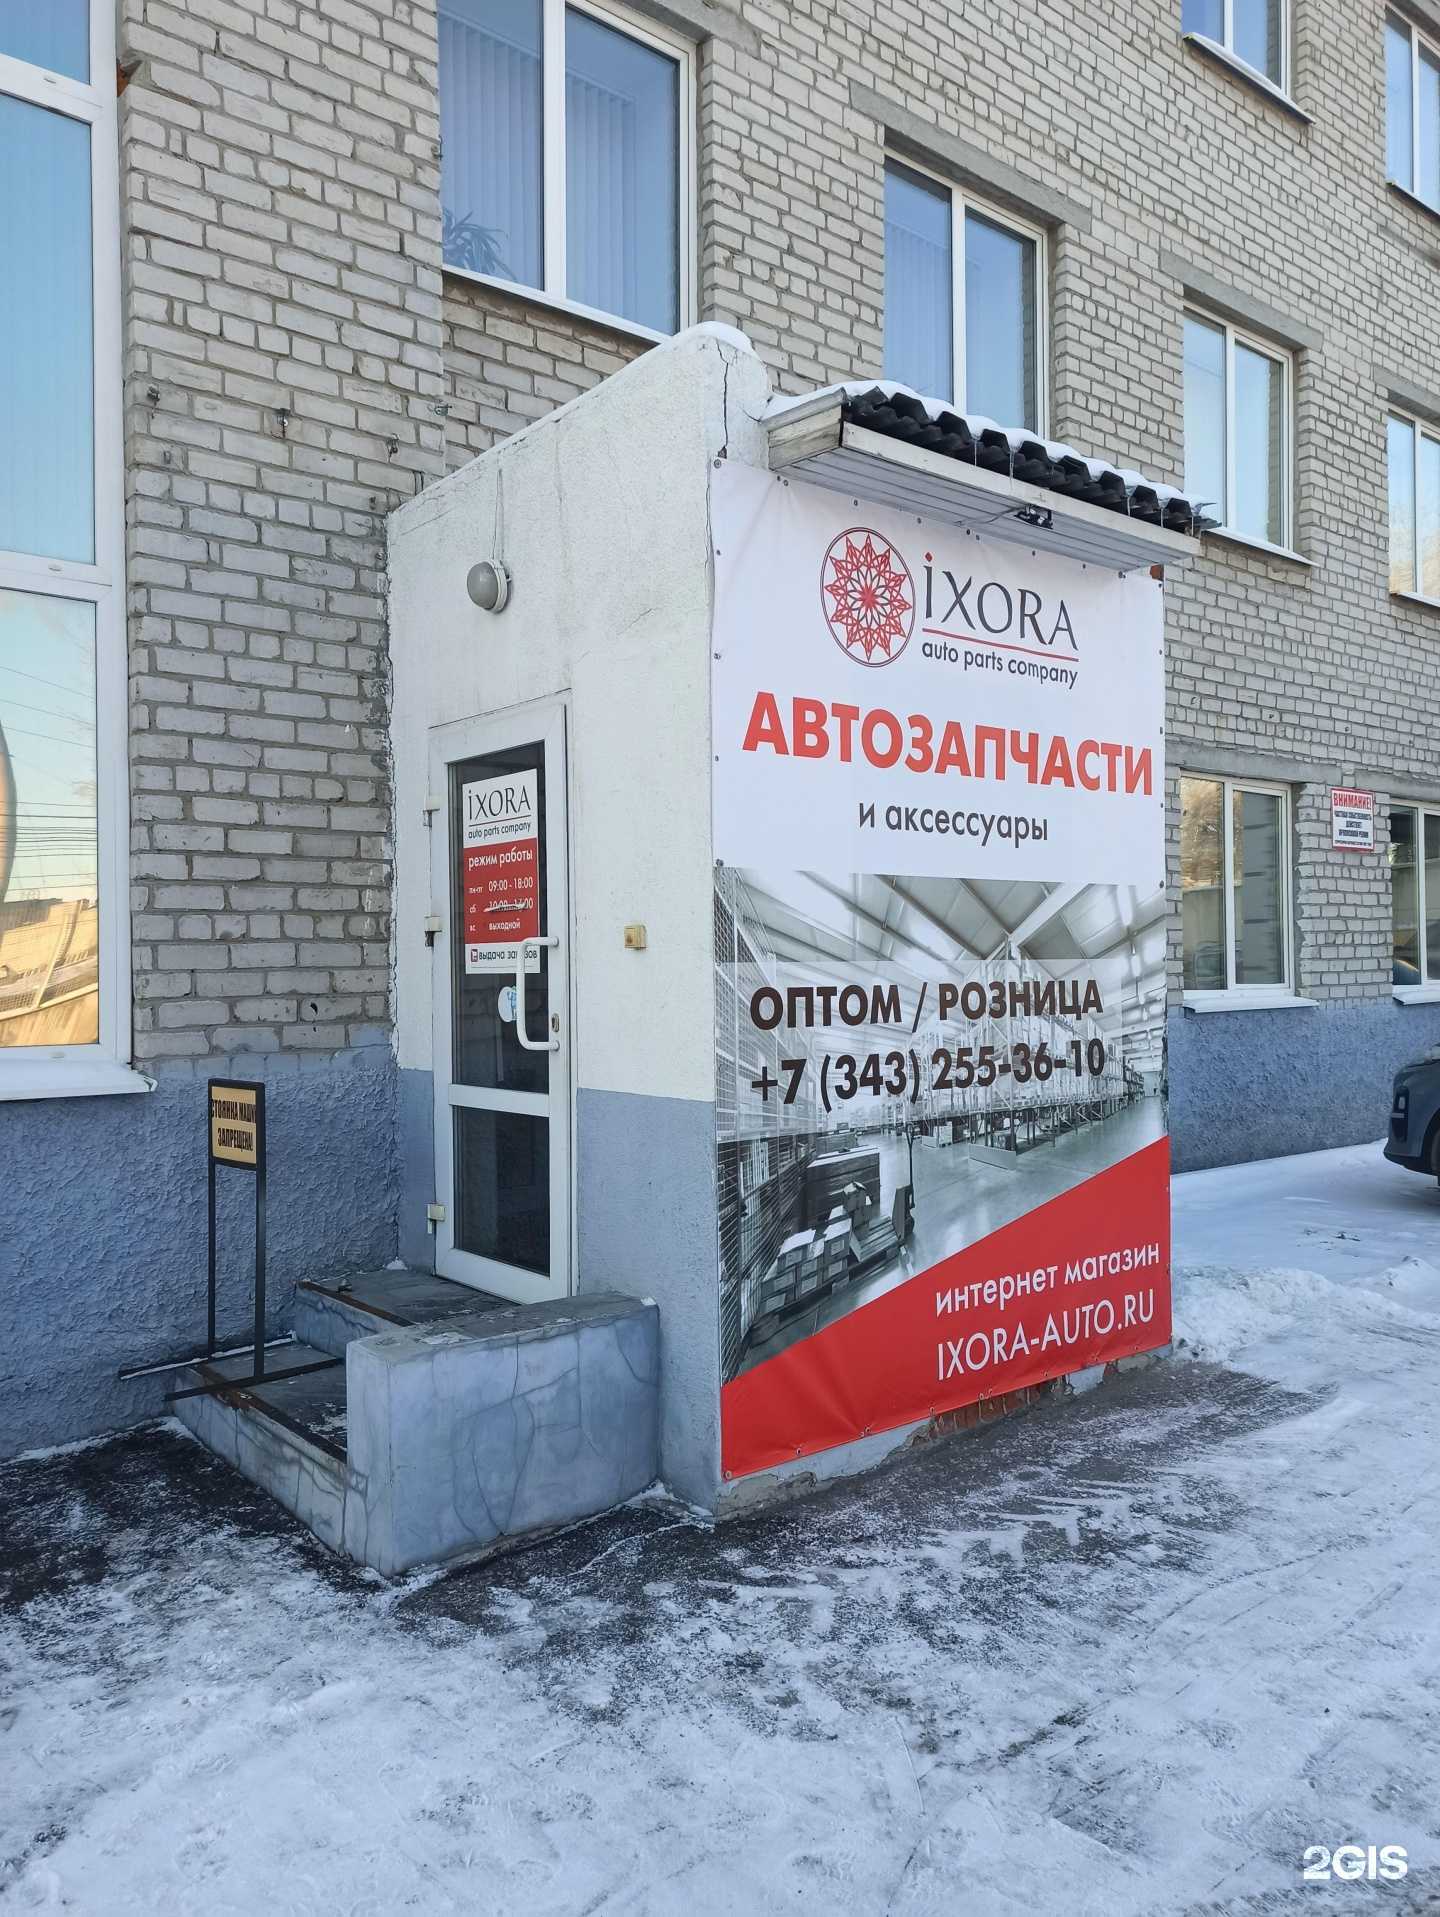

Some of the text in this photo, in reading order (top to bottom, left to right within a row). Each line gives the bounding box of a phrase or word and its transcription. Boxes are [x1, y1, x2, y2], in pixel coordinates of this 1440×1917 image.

[921, 641, 1079, 690] auto parts company
[741, 690, 1154, 796] АВТОЗАПЧАСТИ
[468, 822, 531, 840] auto parts company
[858, 802, 1049, 848] и аксессуары
[468, 846, 533, 871] режим работы
[488, 879, 508, 892] 09:00
[513, 876, 533, 889] 18:00
[488, 918, 521, 931] выходной
[479, 949, 538, 961] выдача зазов
[749, 979, 1104, 1033] ОПТОМ / РОЗНИЦА
[751, 1038, 1106, 1114] +7 (343) 255-36-10
[935, 1242, 1160, 1318] интернет магазин
[937, 1287, 1155, 1381] IXORA-AUTO.RU
